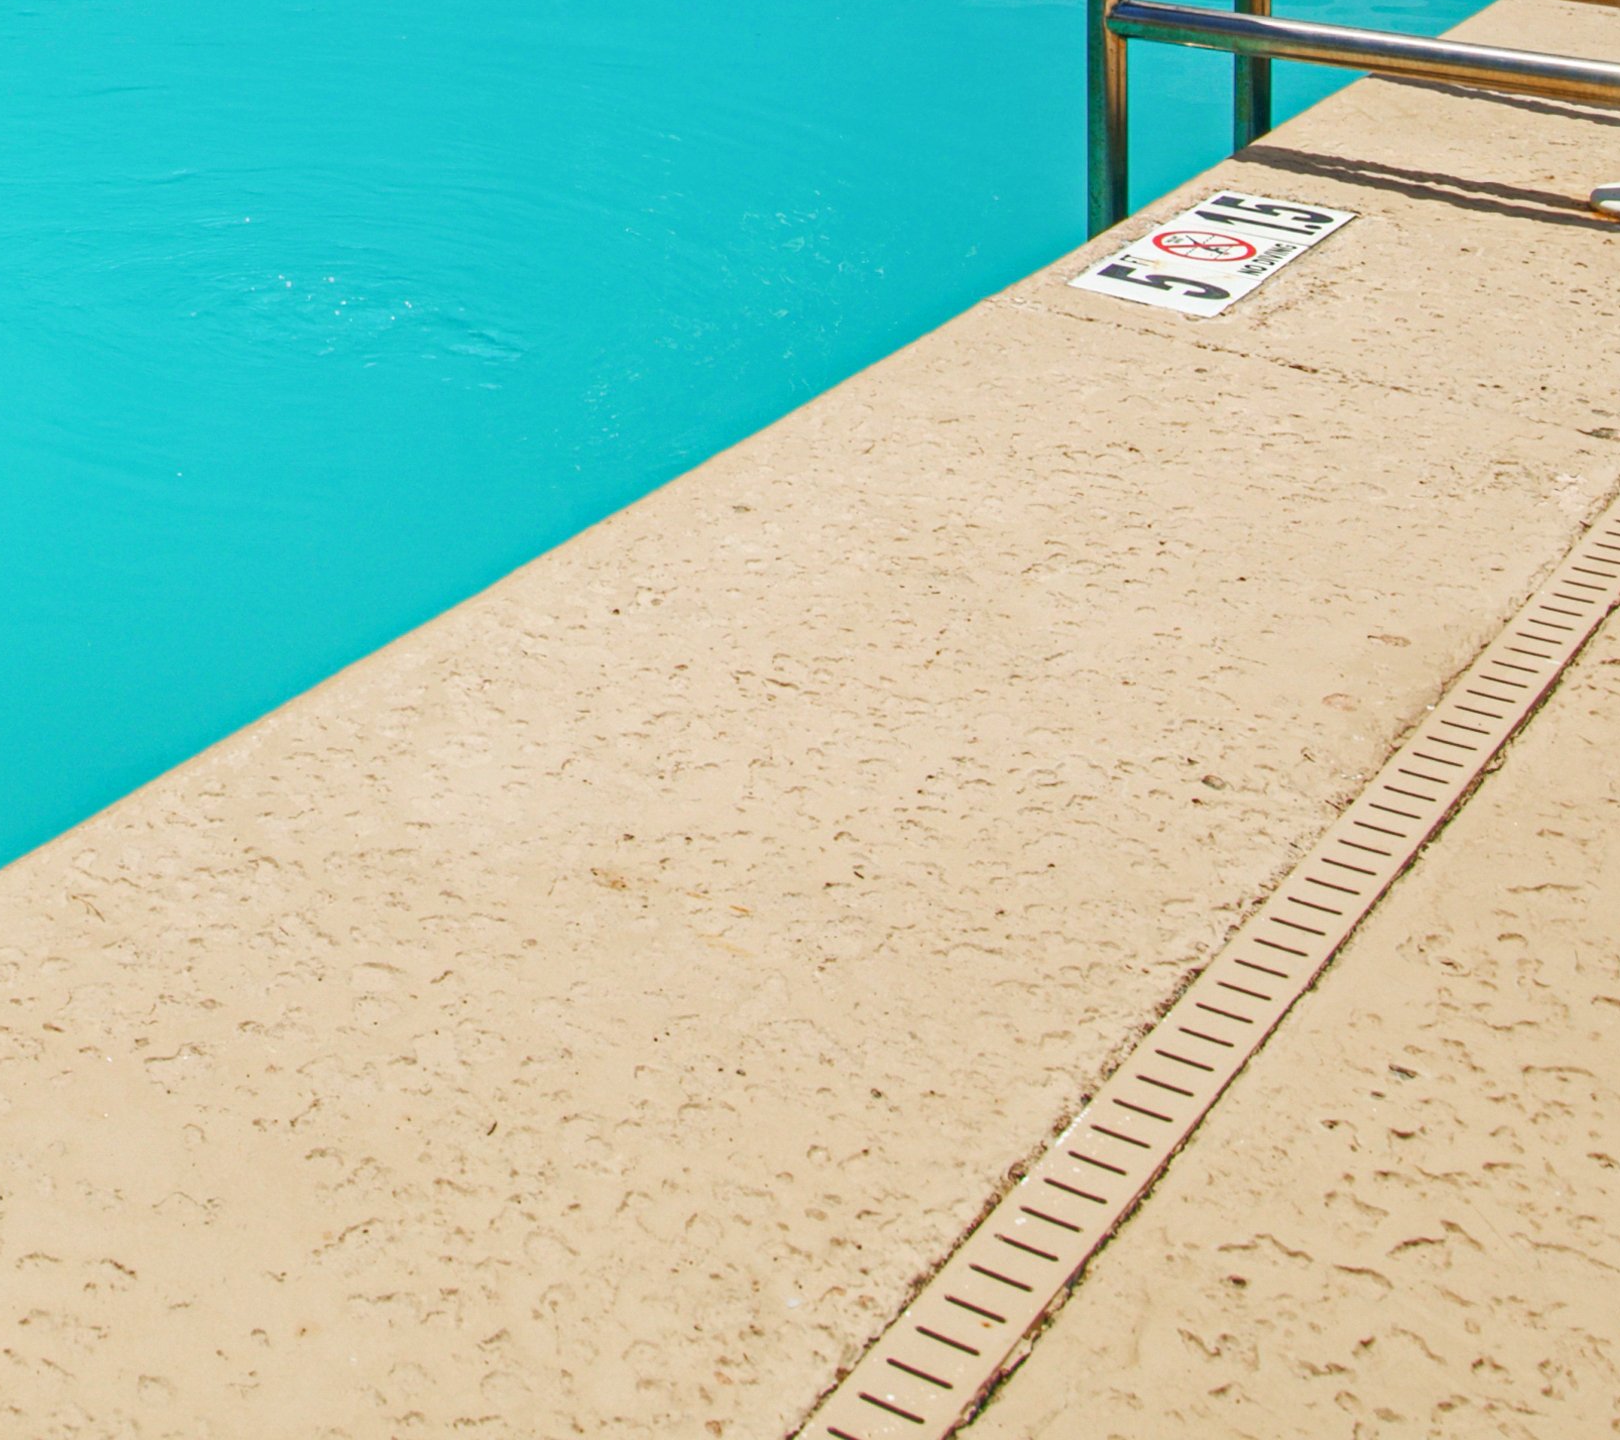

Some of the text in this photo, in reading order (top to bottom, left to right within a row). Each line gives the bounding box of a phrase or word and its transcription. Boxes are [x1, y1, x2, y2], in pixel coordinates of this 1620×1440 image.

[1237, 243, 1298, 276] NO DIVING
[1097, 263, 1231, 300] 5
